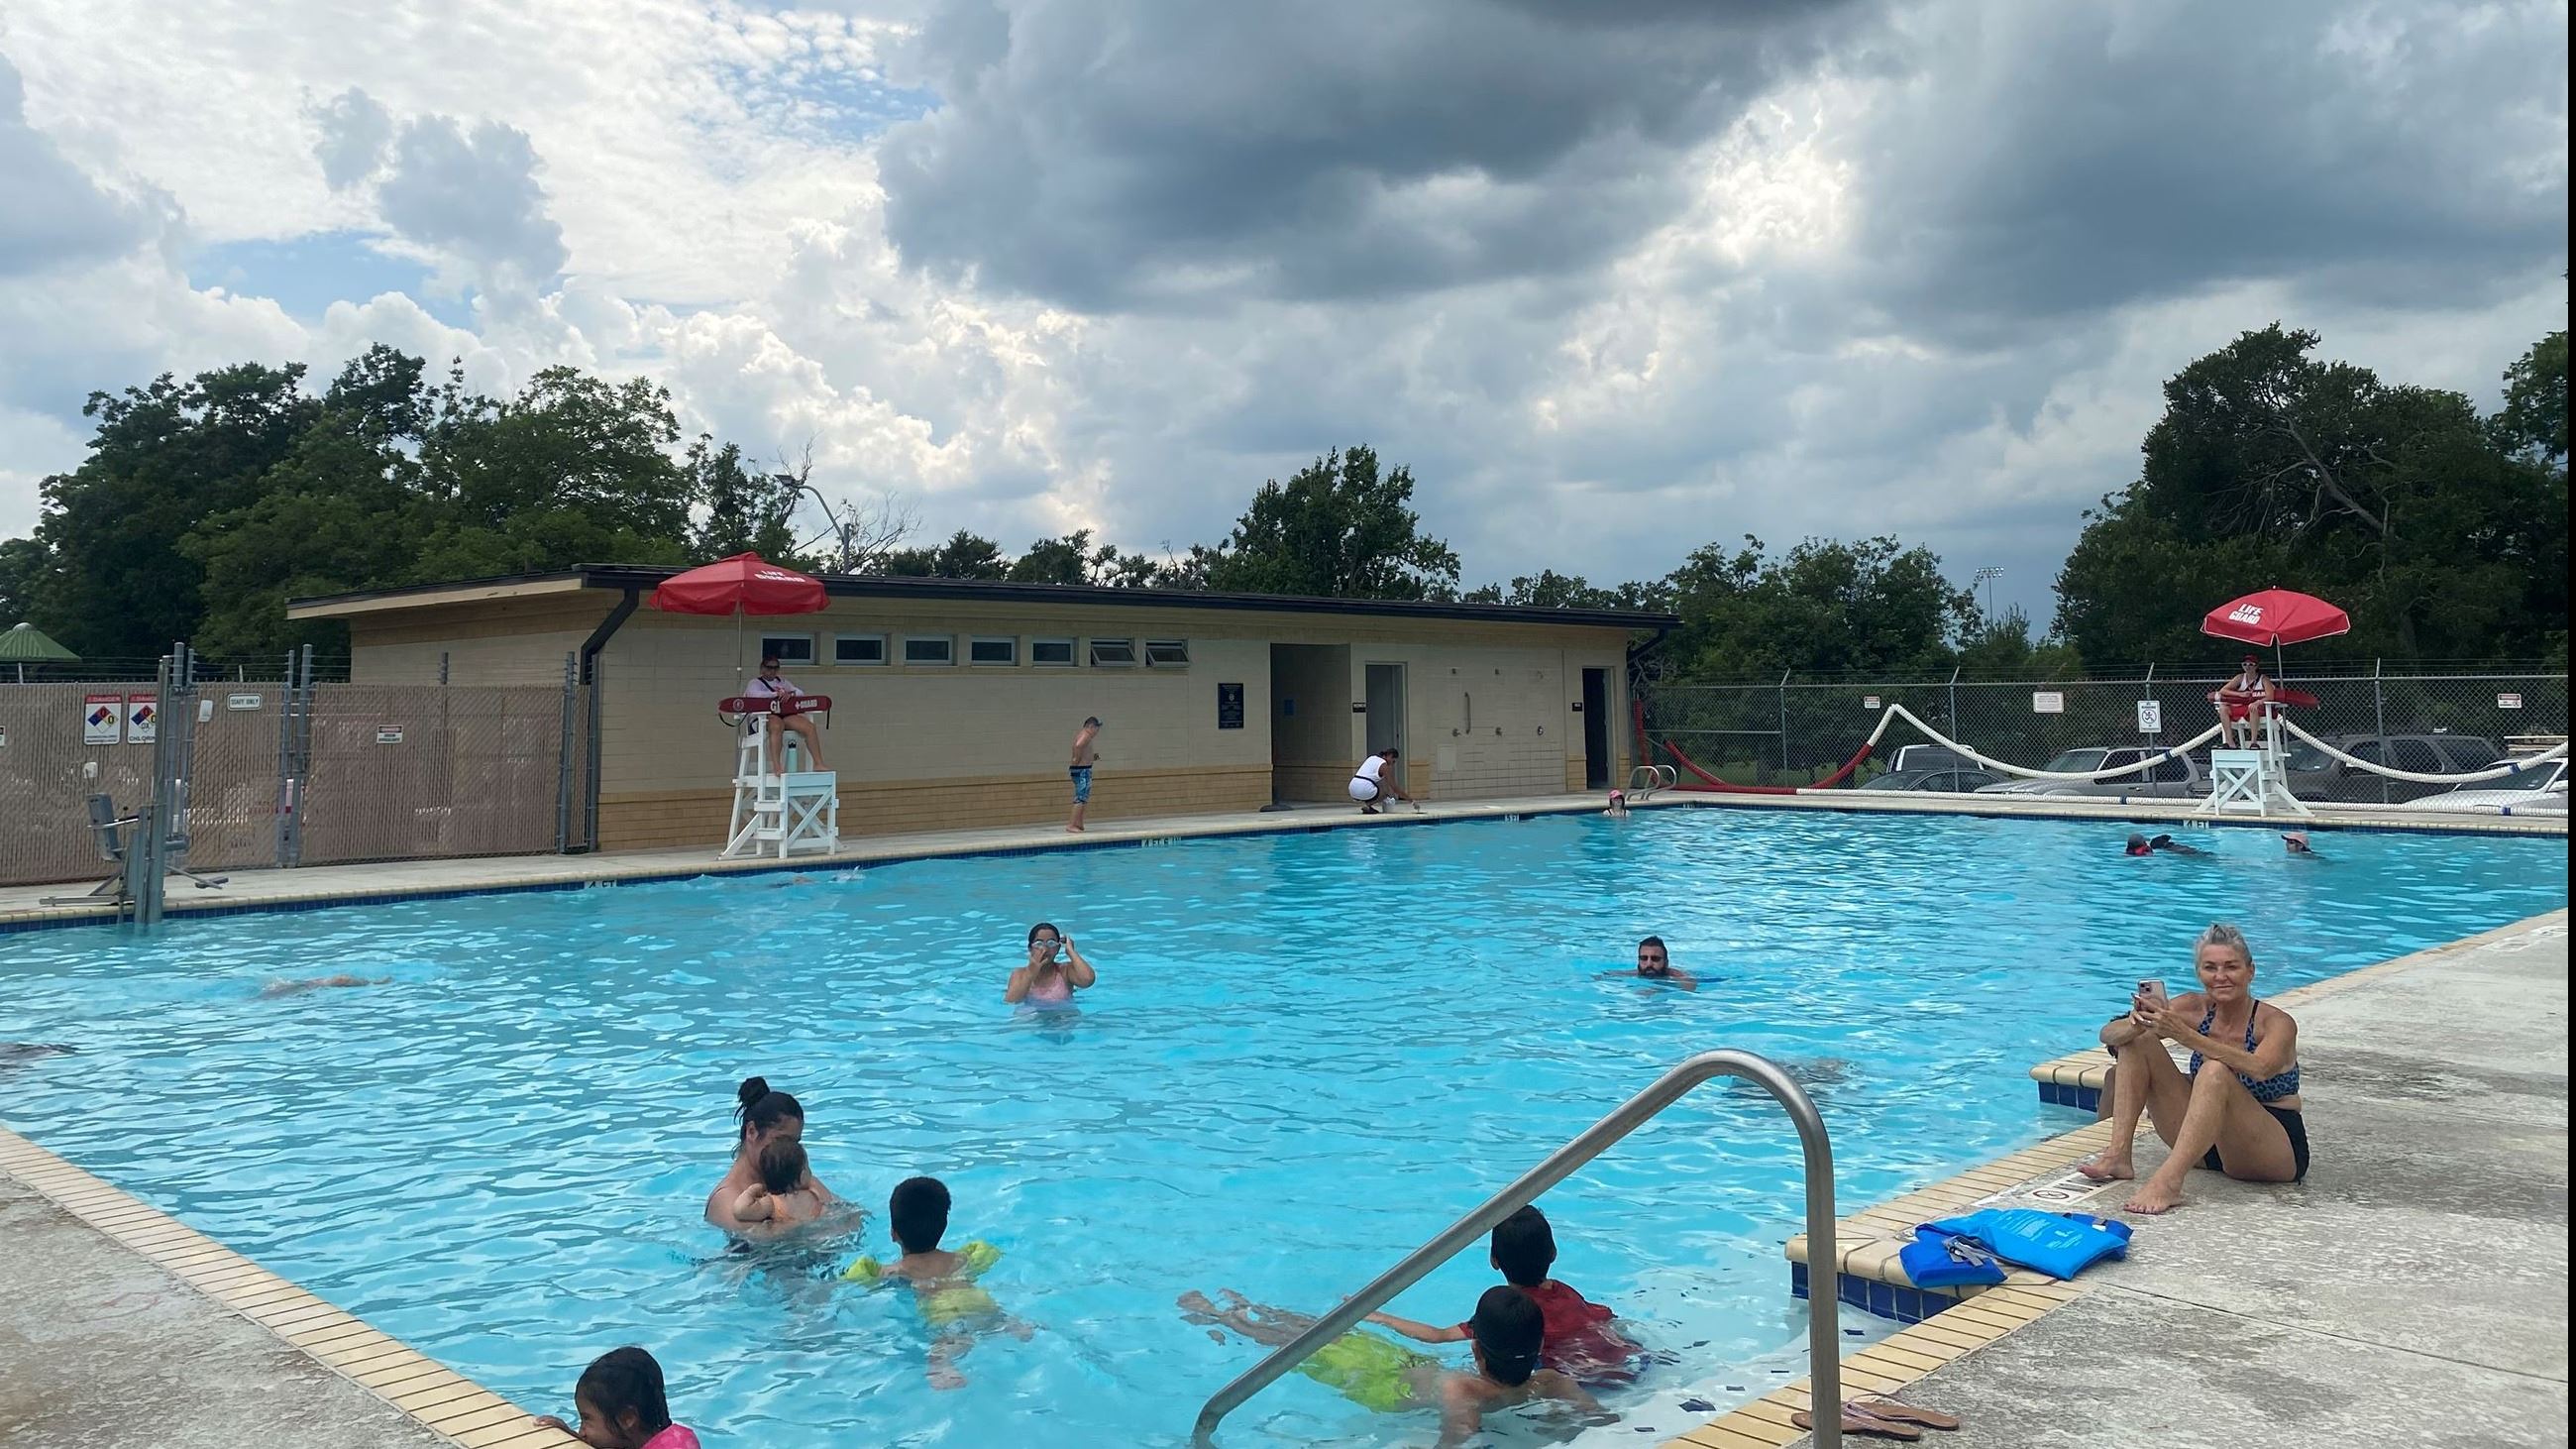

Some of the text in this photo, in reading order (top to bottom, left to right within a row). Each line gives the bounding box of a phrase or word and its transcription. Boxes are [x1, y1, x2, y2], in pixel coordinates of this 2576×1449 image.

[2238, 604, 2264, 614] LIFE
[2228, 611, 2261, 624] GUARD
[107, 715, 115, 724] 0
